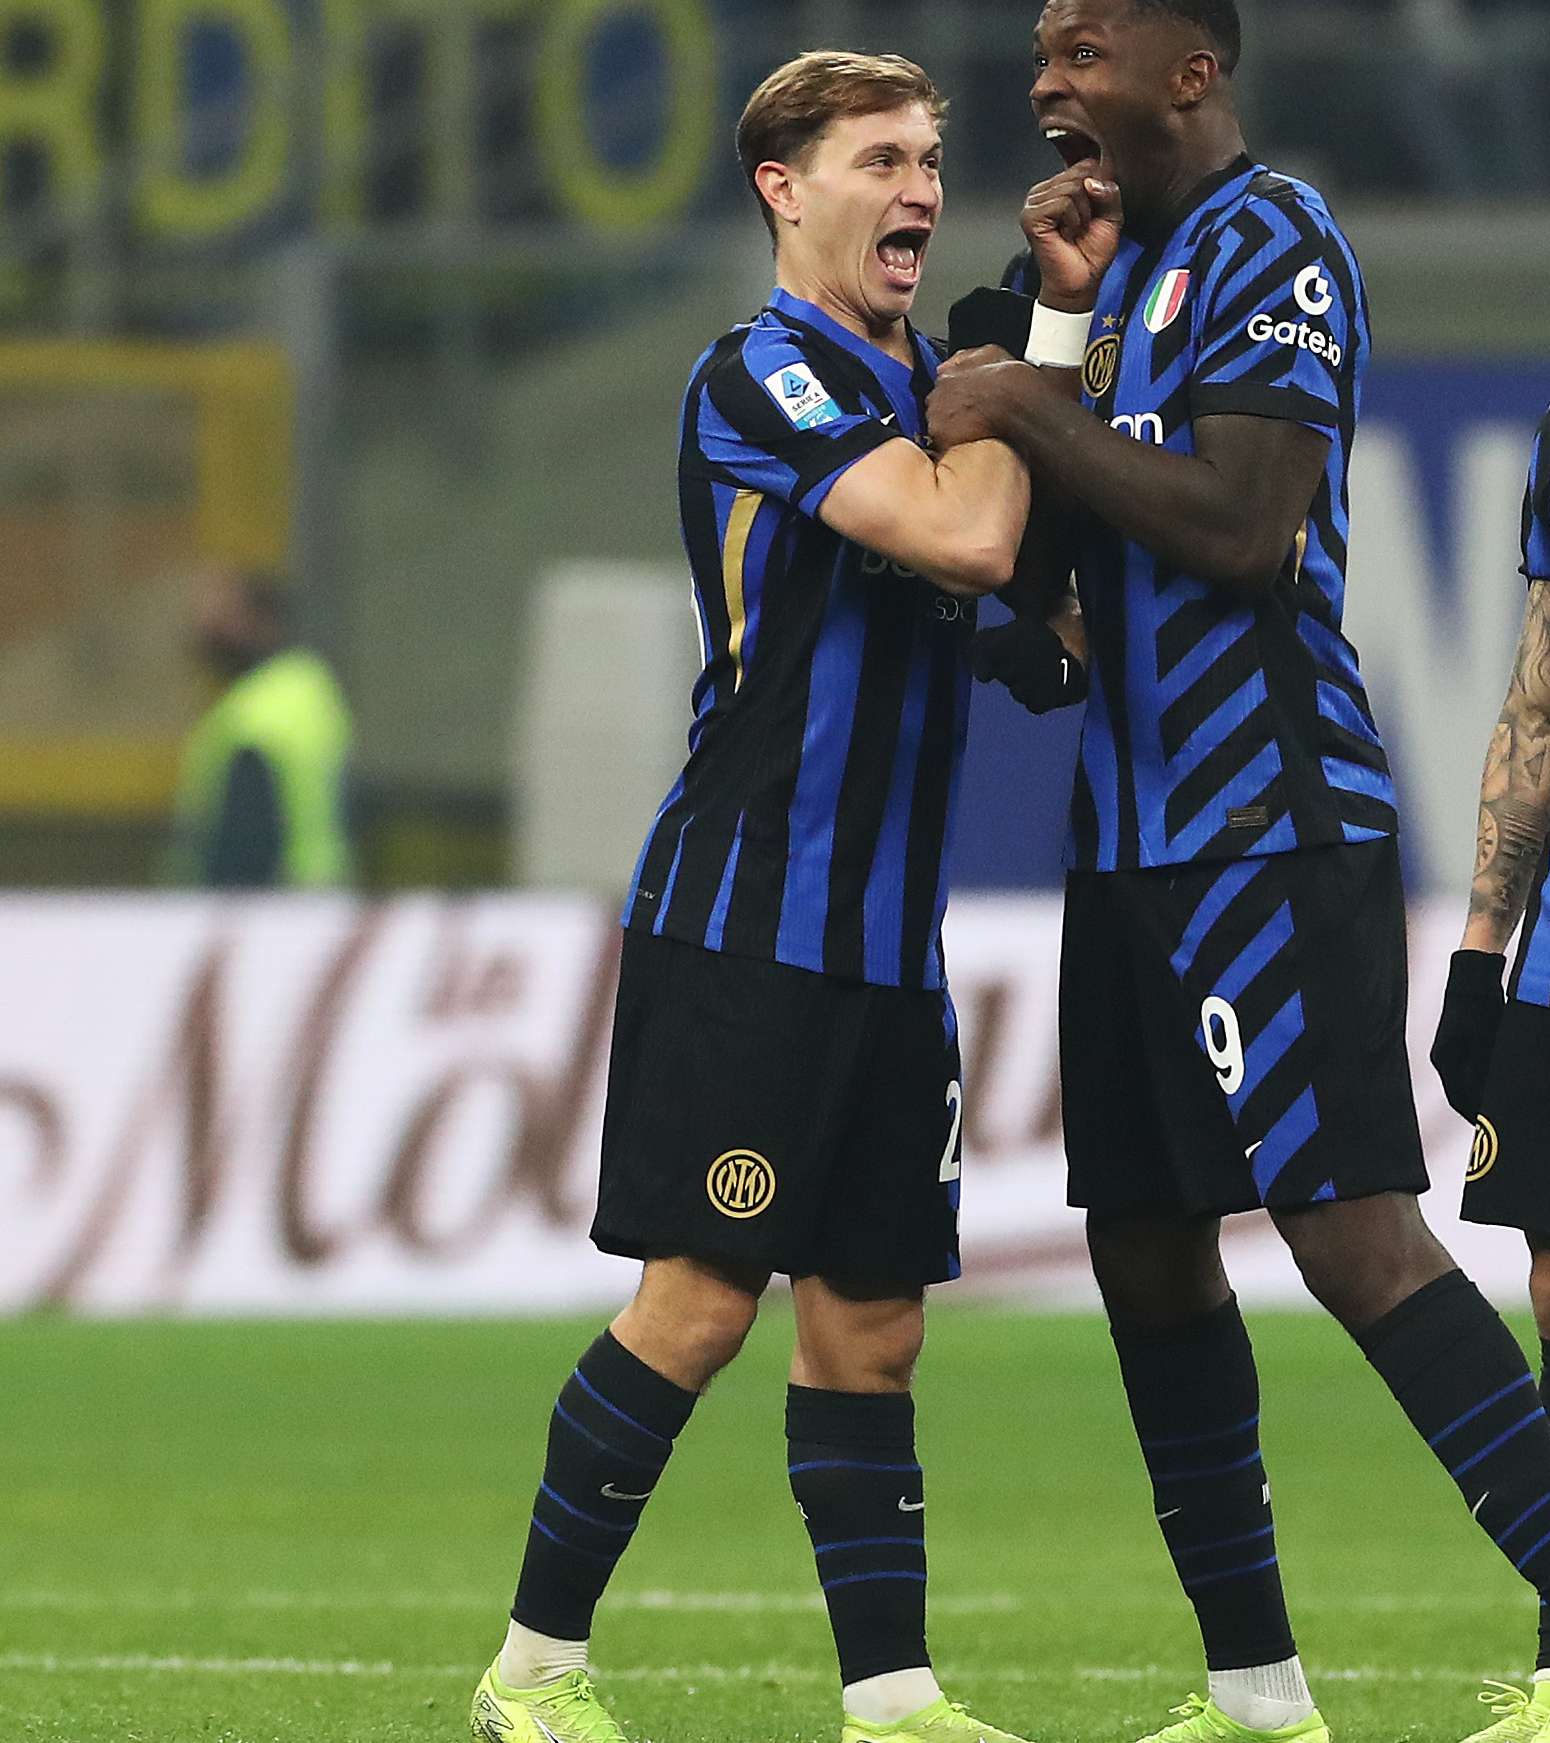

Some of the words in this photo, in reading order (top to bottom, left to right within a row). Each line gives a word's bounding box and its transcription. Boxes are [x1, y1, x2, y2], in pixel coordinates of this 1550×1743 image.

[1246, 312, 1342, 368] Gate.io
[1201, 996, 1245, 1095] 9
[938, 1079, 962, 1182] 2
